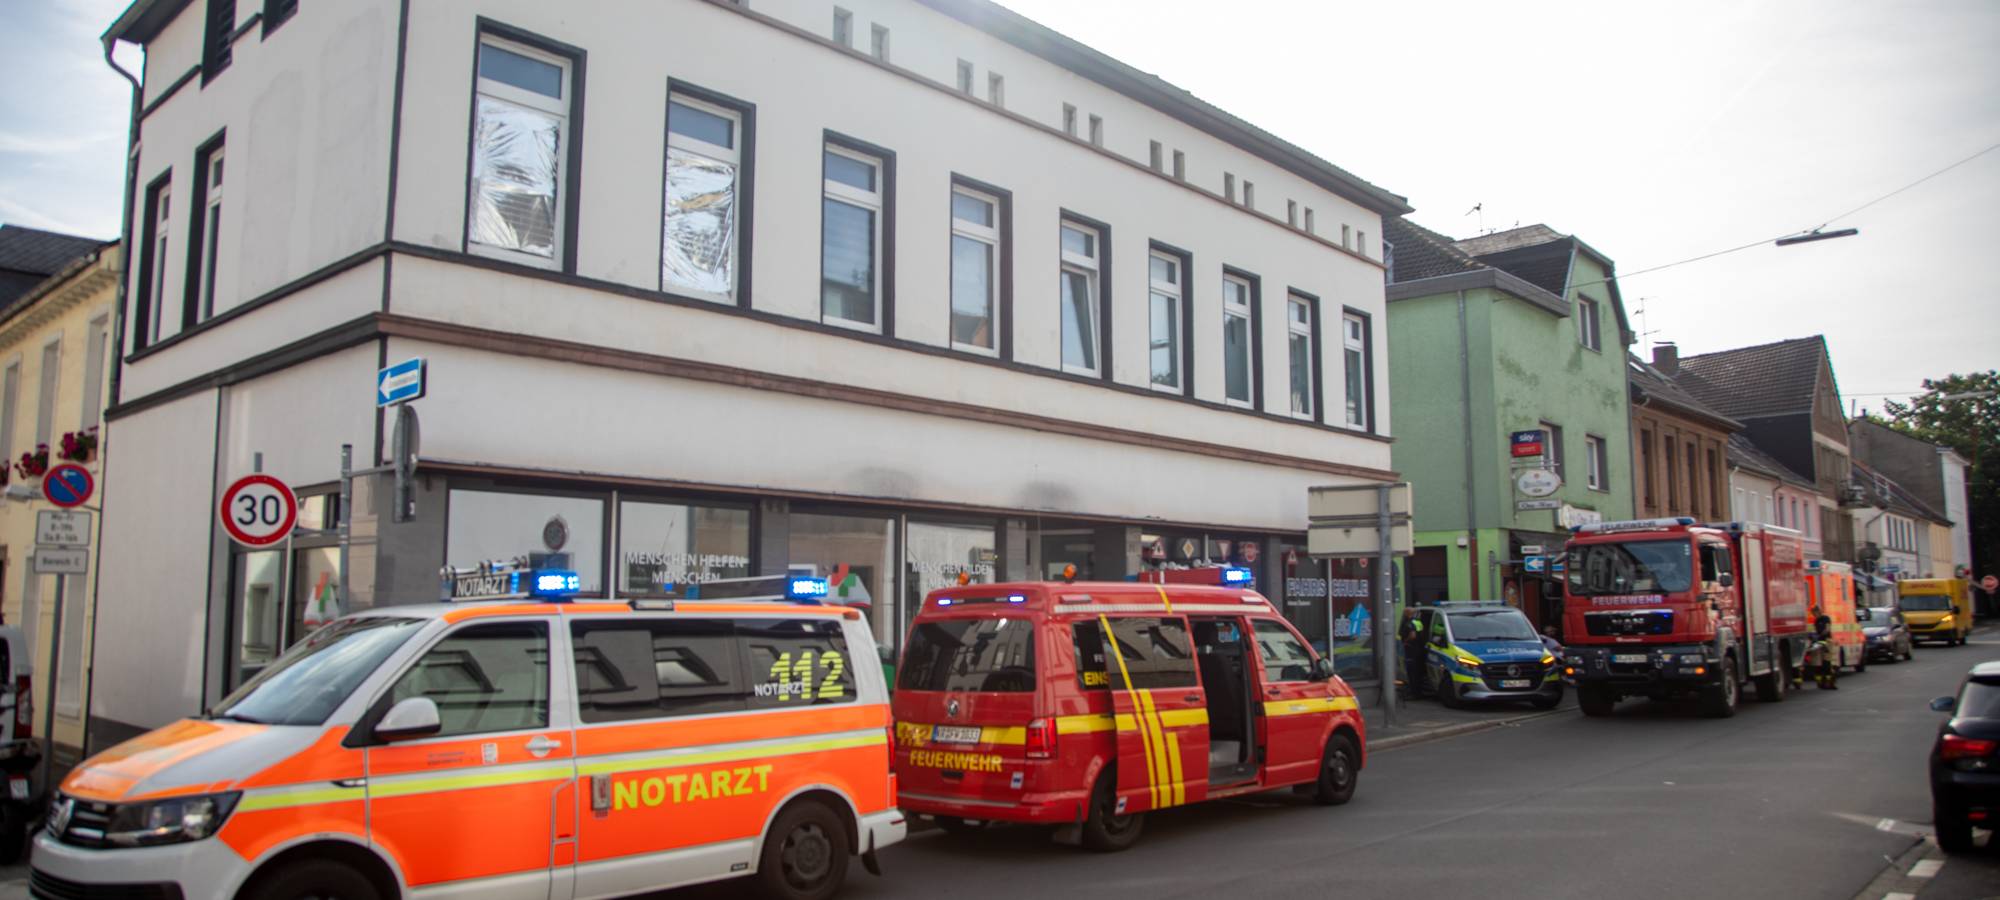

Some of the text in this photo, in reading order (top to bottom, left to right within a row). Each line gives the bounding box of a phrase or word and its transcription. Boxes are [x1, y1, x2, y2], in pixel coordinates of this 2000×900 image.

[1518, 434, 1534, 442] sky
[237, 494, 280, 526] 30
[625, 551, 744, 568] MENSCHEN HELFEN
[456, 575, 508, 597] NOTARZT
[652, 571, 720, 585] MENSCHEN
[1592, 595, 1663, 605] FEUERWEHR
[770, 650, 844, 701] 112
[909, 749, 1003, 772] FEUERWEHR
[613, 764, 773, 811] NOTARZT
